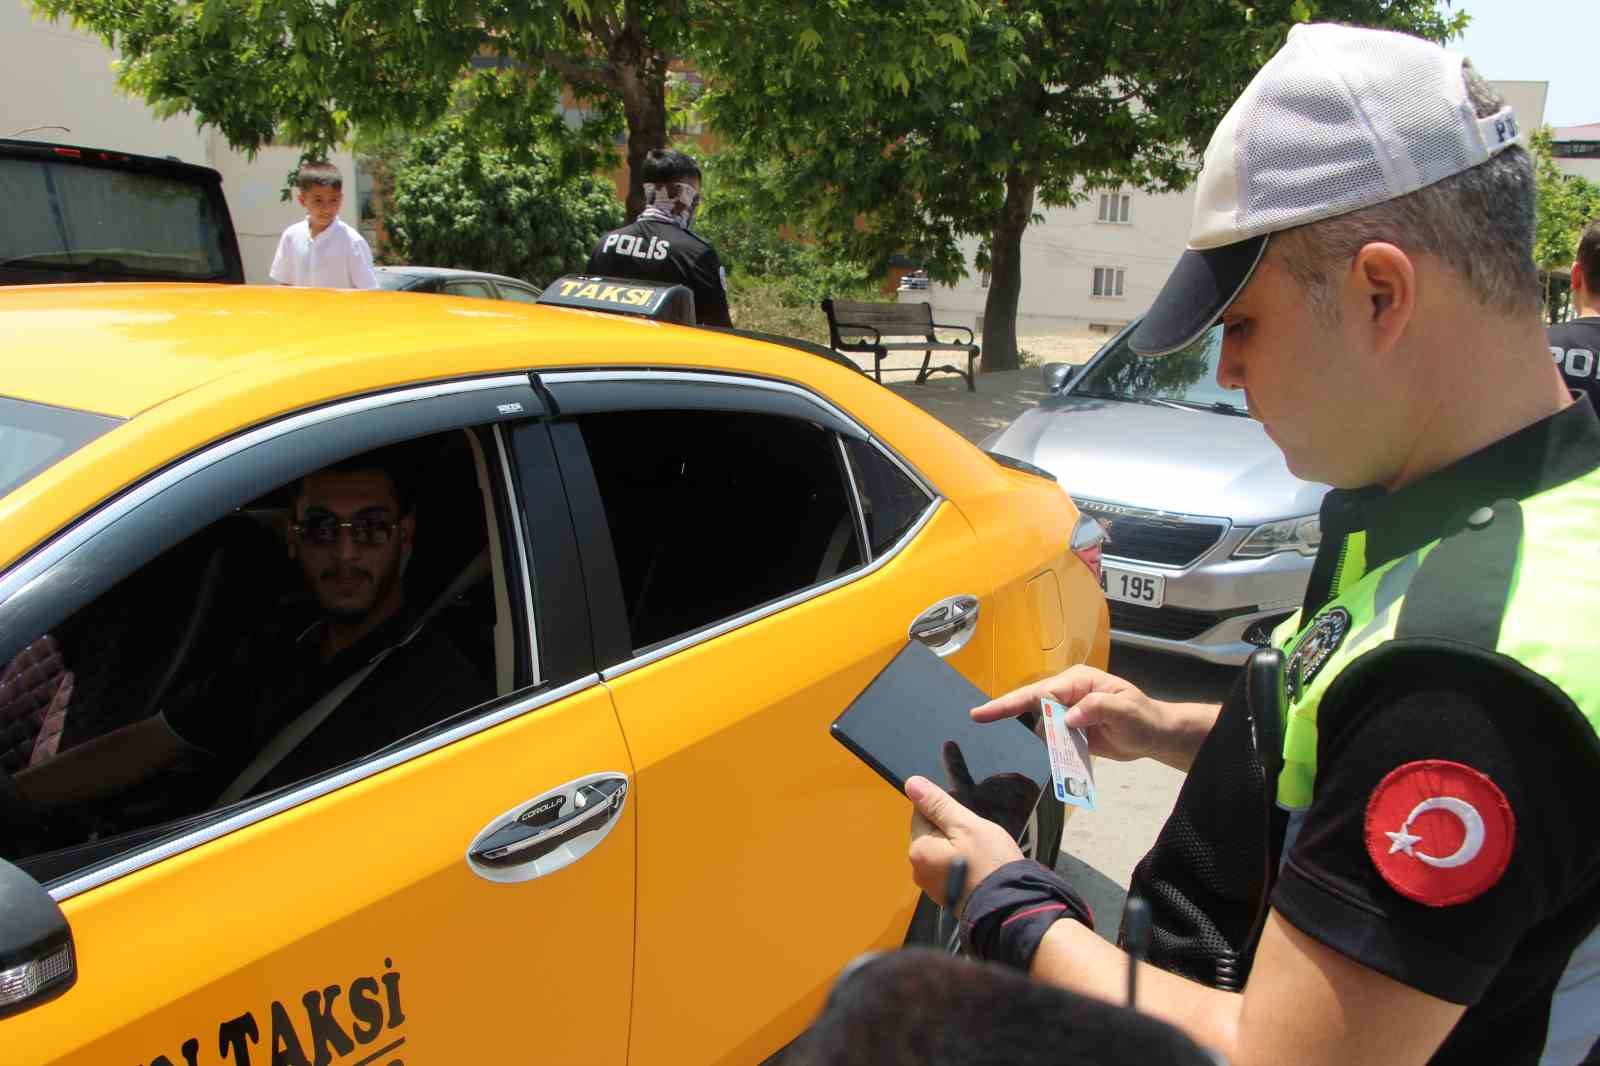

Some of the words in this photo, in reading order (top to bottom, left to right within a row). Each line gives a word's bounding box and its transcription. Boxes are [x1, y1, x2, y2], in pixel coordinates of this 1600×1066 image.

[603, 234, 671, 260] POLİS
[1121, 574, 1155, 601] 195
[521, 796, 564, 821] COROLLA
[219, 957, 406, 1066] TAKSİ
